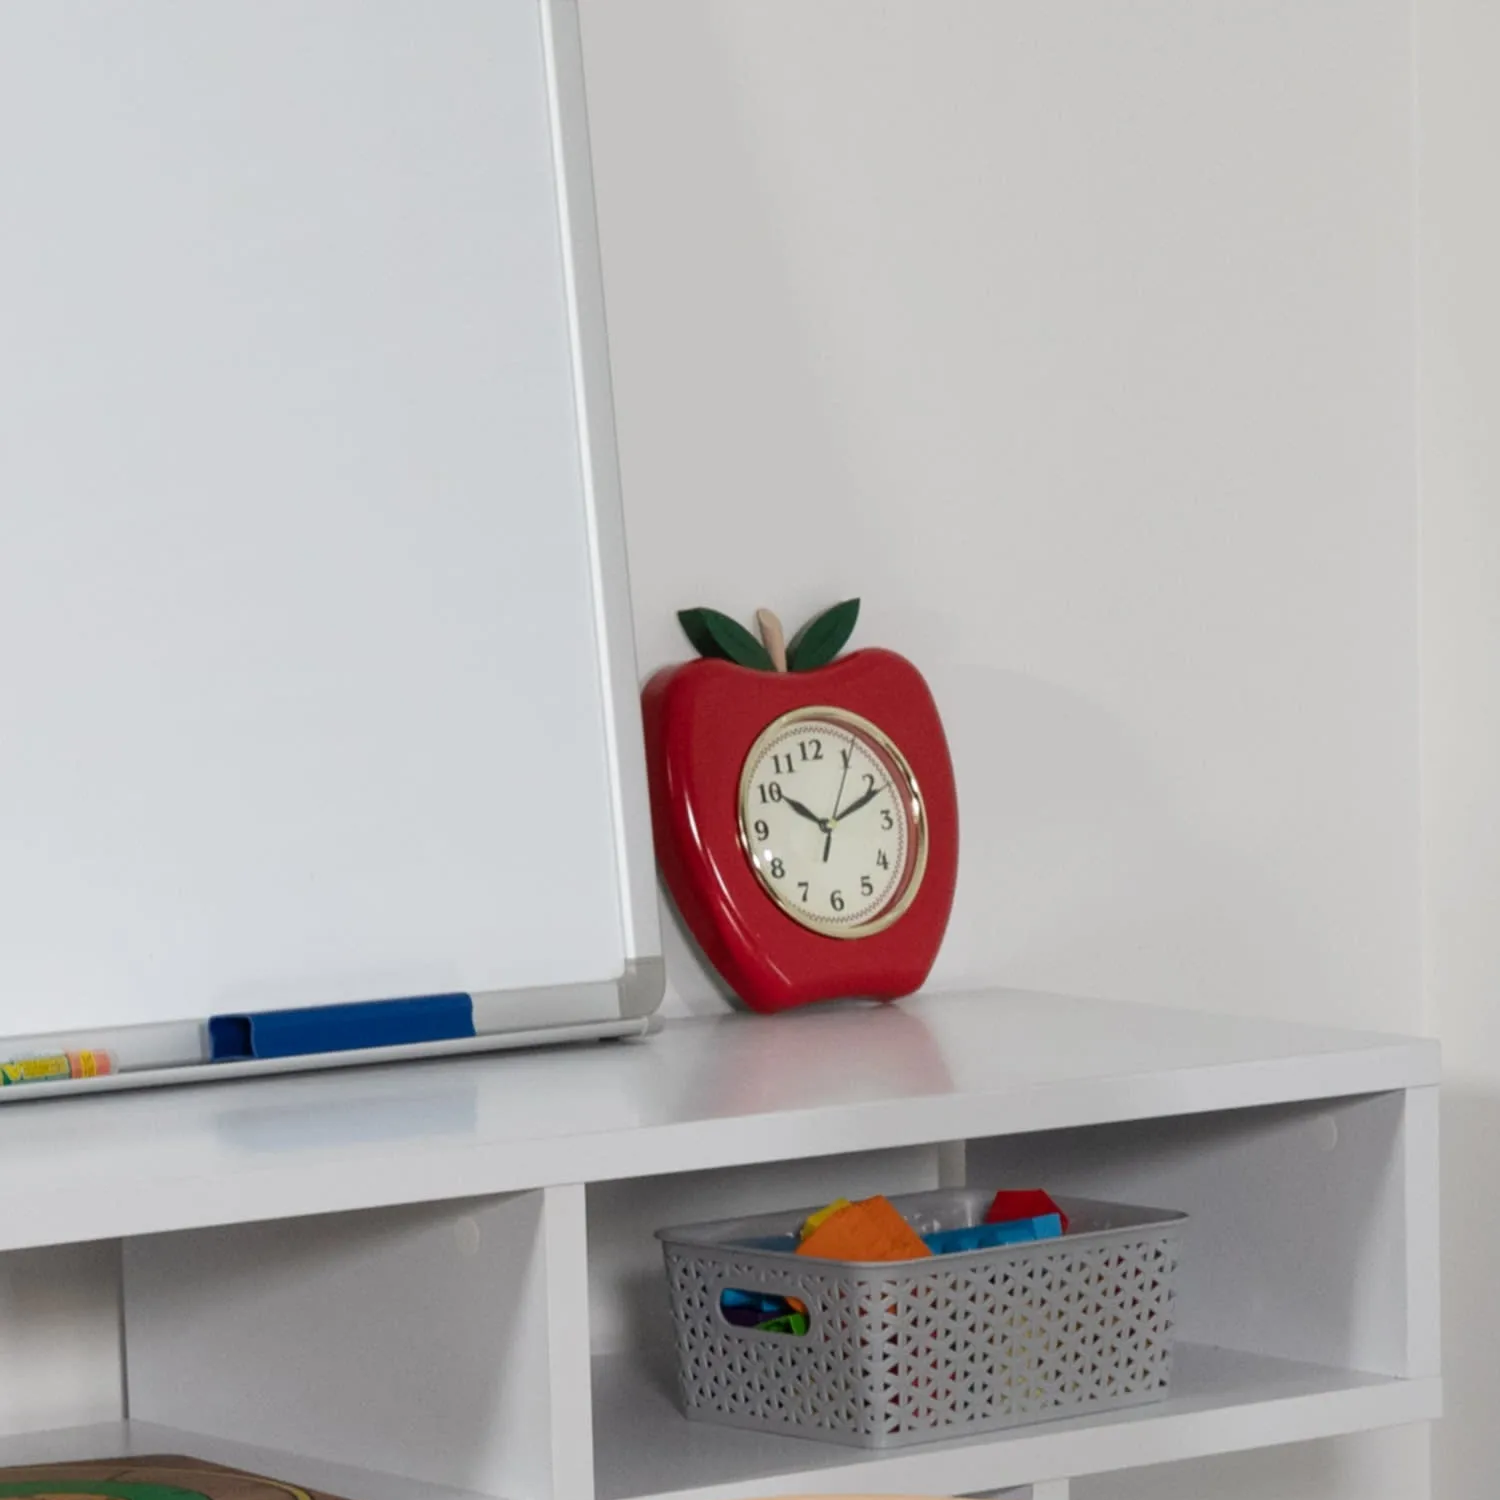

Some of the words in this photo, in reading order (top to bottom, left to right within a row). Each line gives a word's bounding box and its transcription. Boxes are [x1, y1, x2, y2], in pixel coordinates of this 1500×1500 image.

[798, 739, 823, 761] 12
[841, 748, 852, 770] 1
[772, 753, 795, 775] 11
[758, 781, 782, 804] 10
[862, 773, 881, 796] 2
[754, 819, 769, 841] 9
[880, 809, 893, 830] 3
[771, 857, 785, 879] 8
[876, 848, 889, 870] 4
[797, 881, 809, 902] 7
[860, 875, 873, 896] 5
[830, 890, 845, 911] 6
